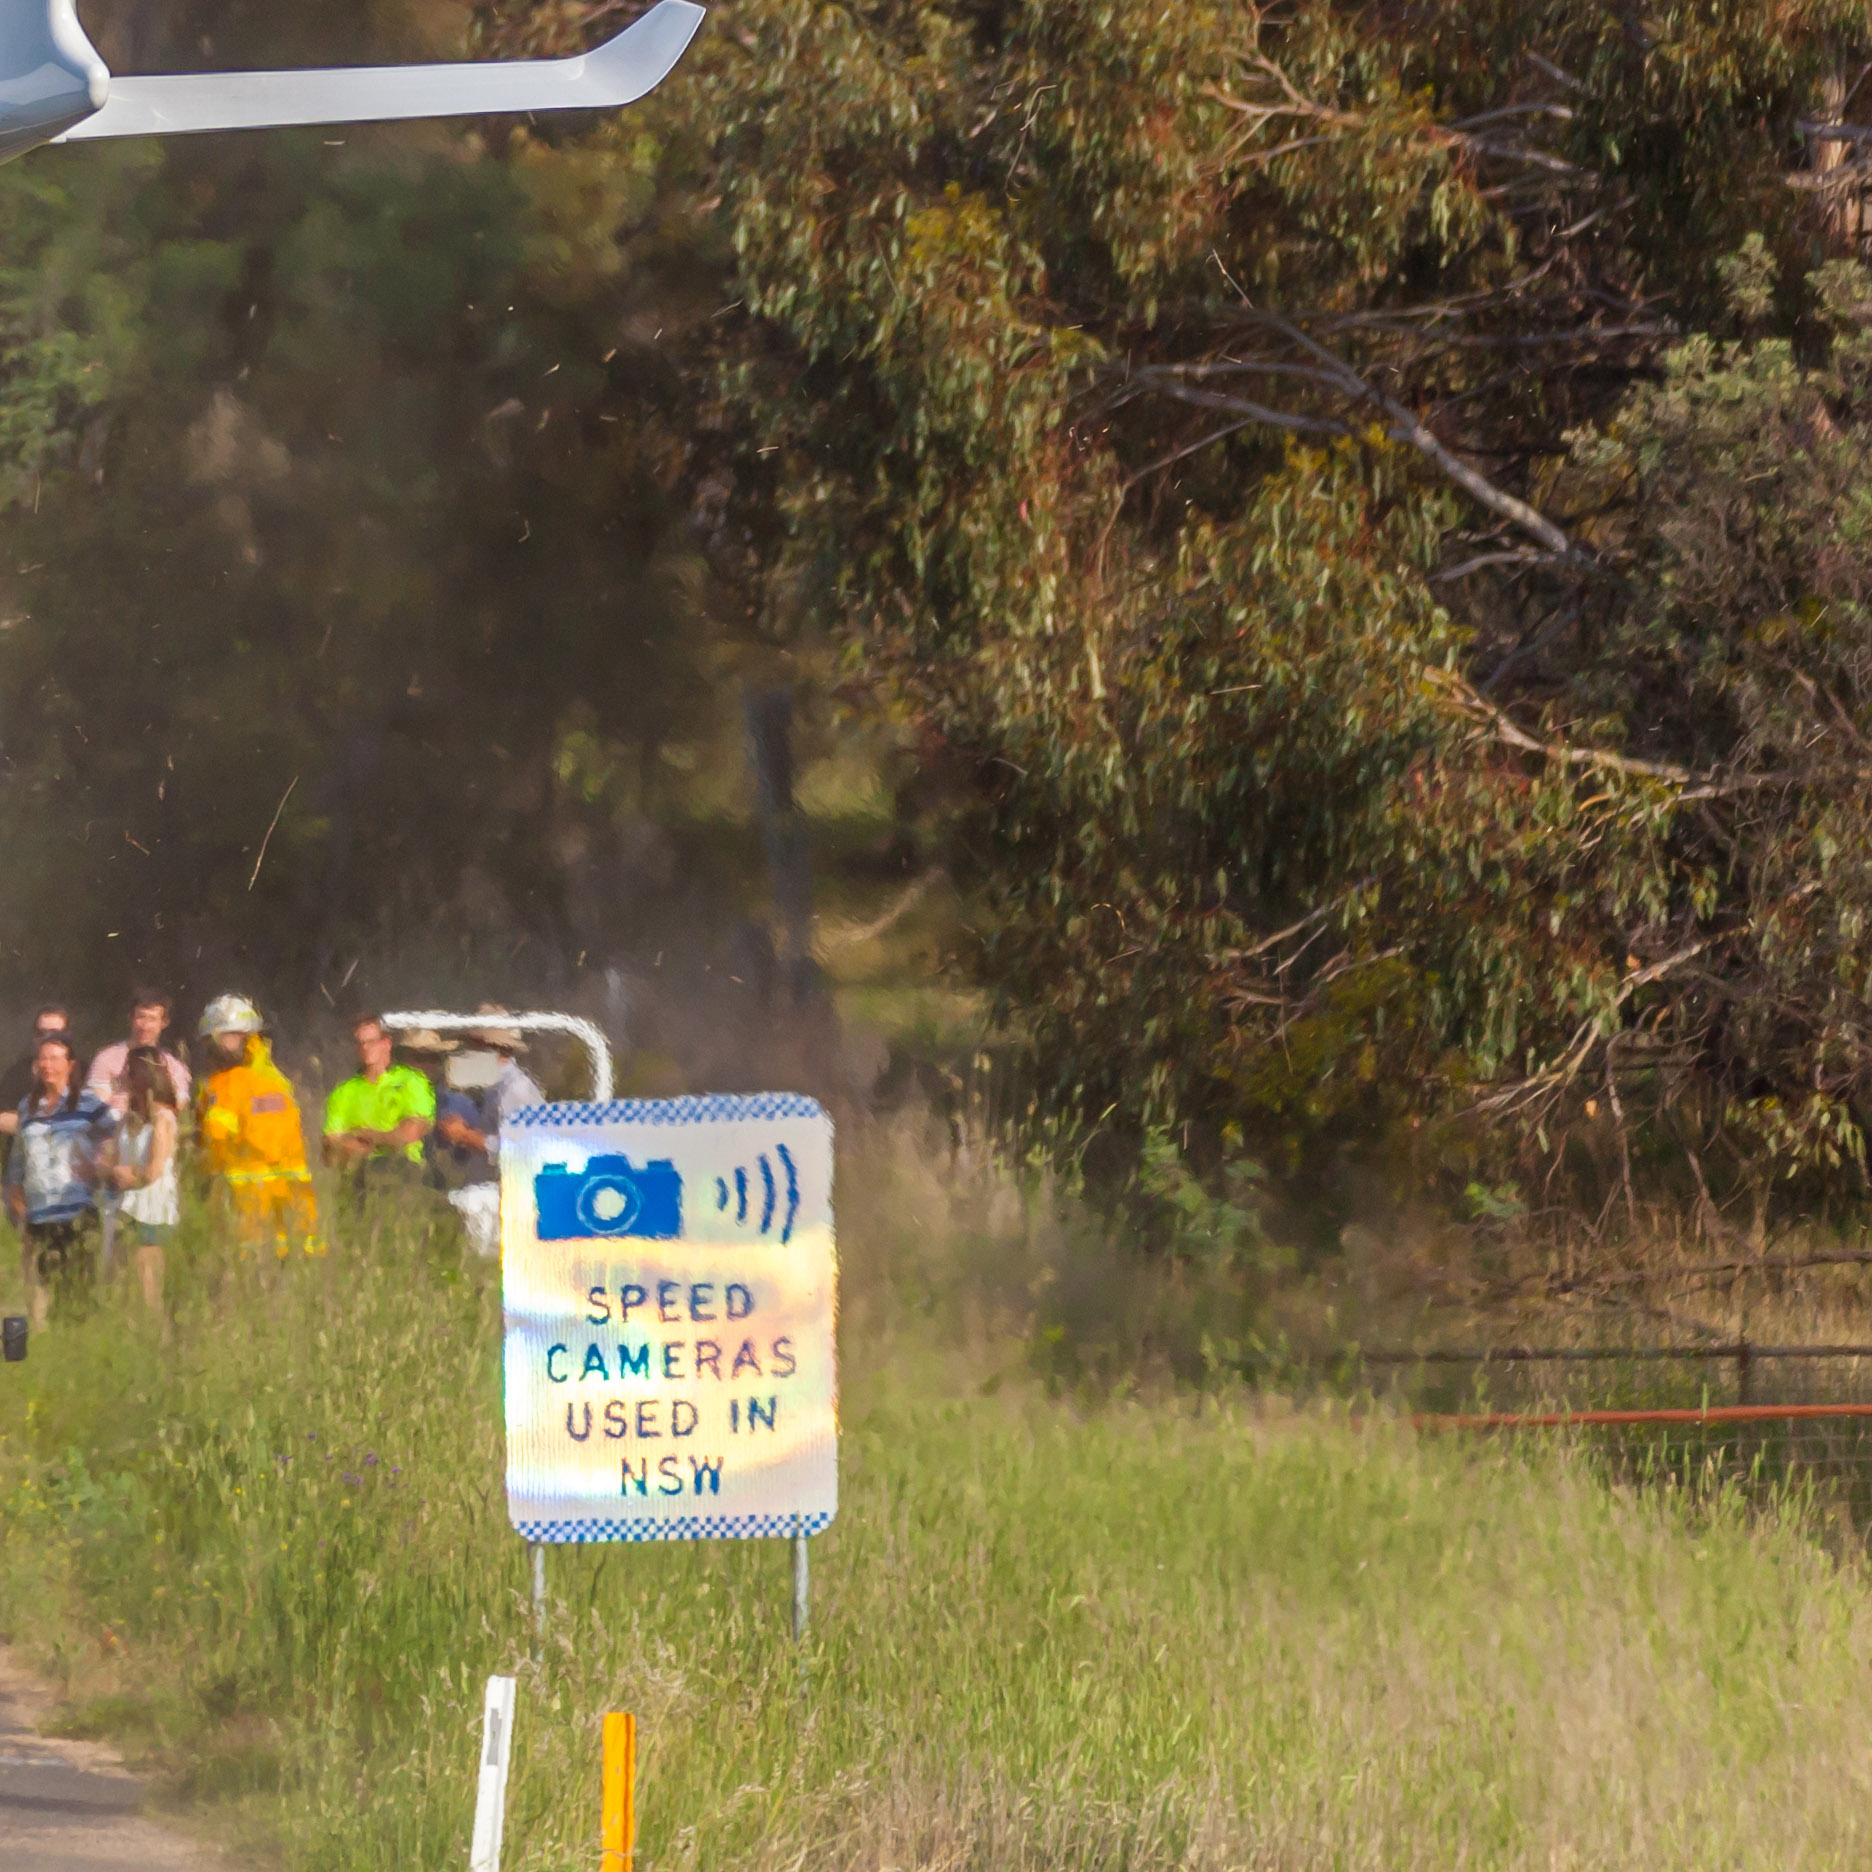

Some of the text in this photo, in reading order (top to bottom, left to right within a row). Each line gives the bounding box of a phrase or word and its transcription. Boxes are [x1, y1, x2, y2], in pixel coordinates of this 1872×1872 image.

[586, 1280, 754, 1326] SPEED
[547, 1336, 798, 1384] CAMERAS
[566, 1396, 777, 1442] USED IN
[620, 1455, 725, 1496] NSW
